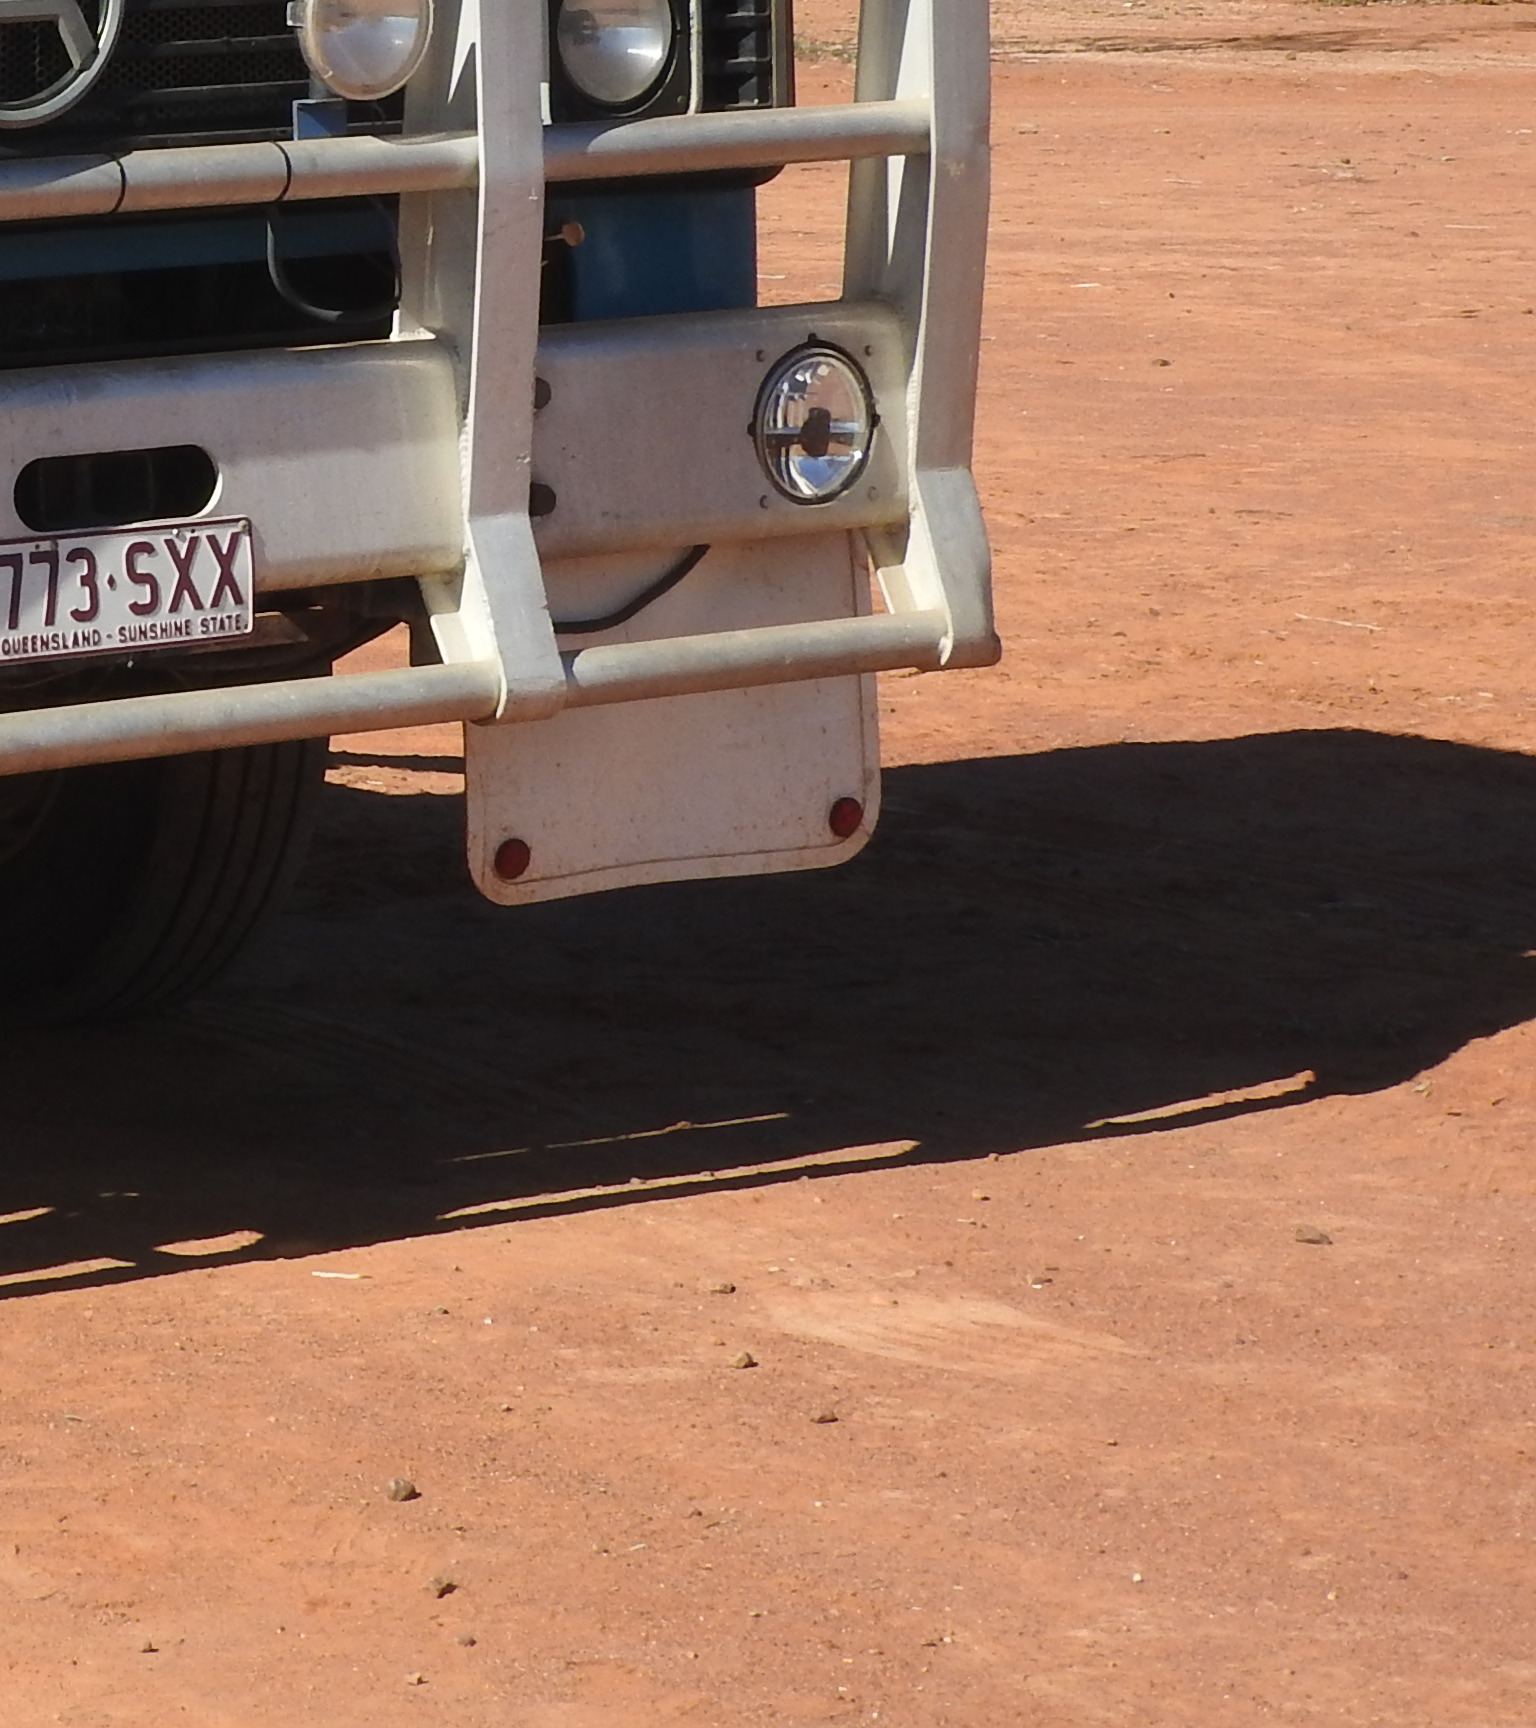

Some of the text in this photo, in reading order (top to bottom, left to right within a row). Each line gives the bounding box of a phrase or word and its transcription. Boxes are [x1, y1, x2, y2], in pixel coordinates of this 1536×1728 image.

[1, 631, 102, 656] QUEENSLAND
[118, 619, 191, 643] SUNSHINE
[199, 613, 242, 634] STATE
